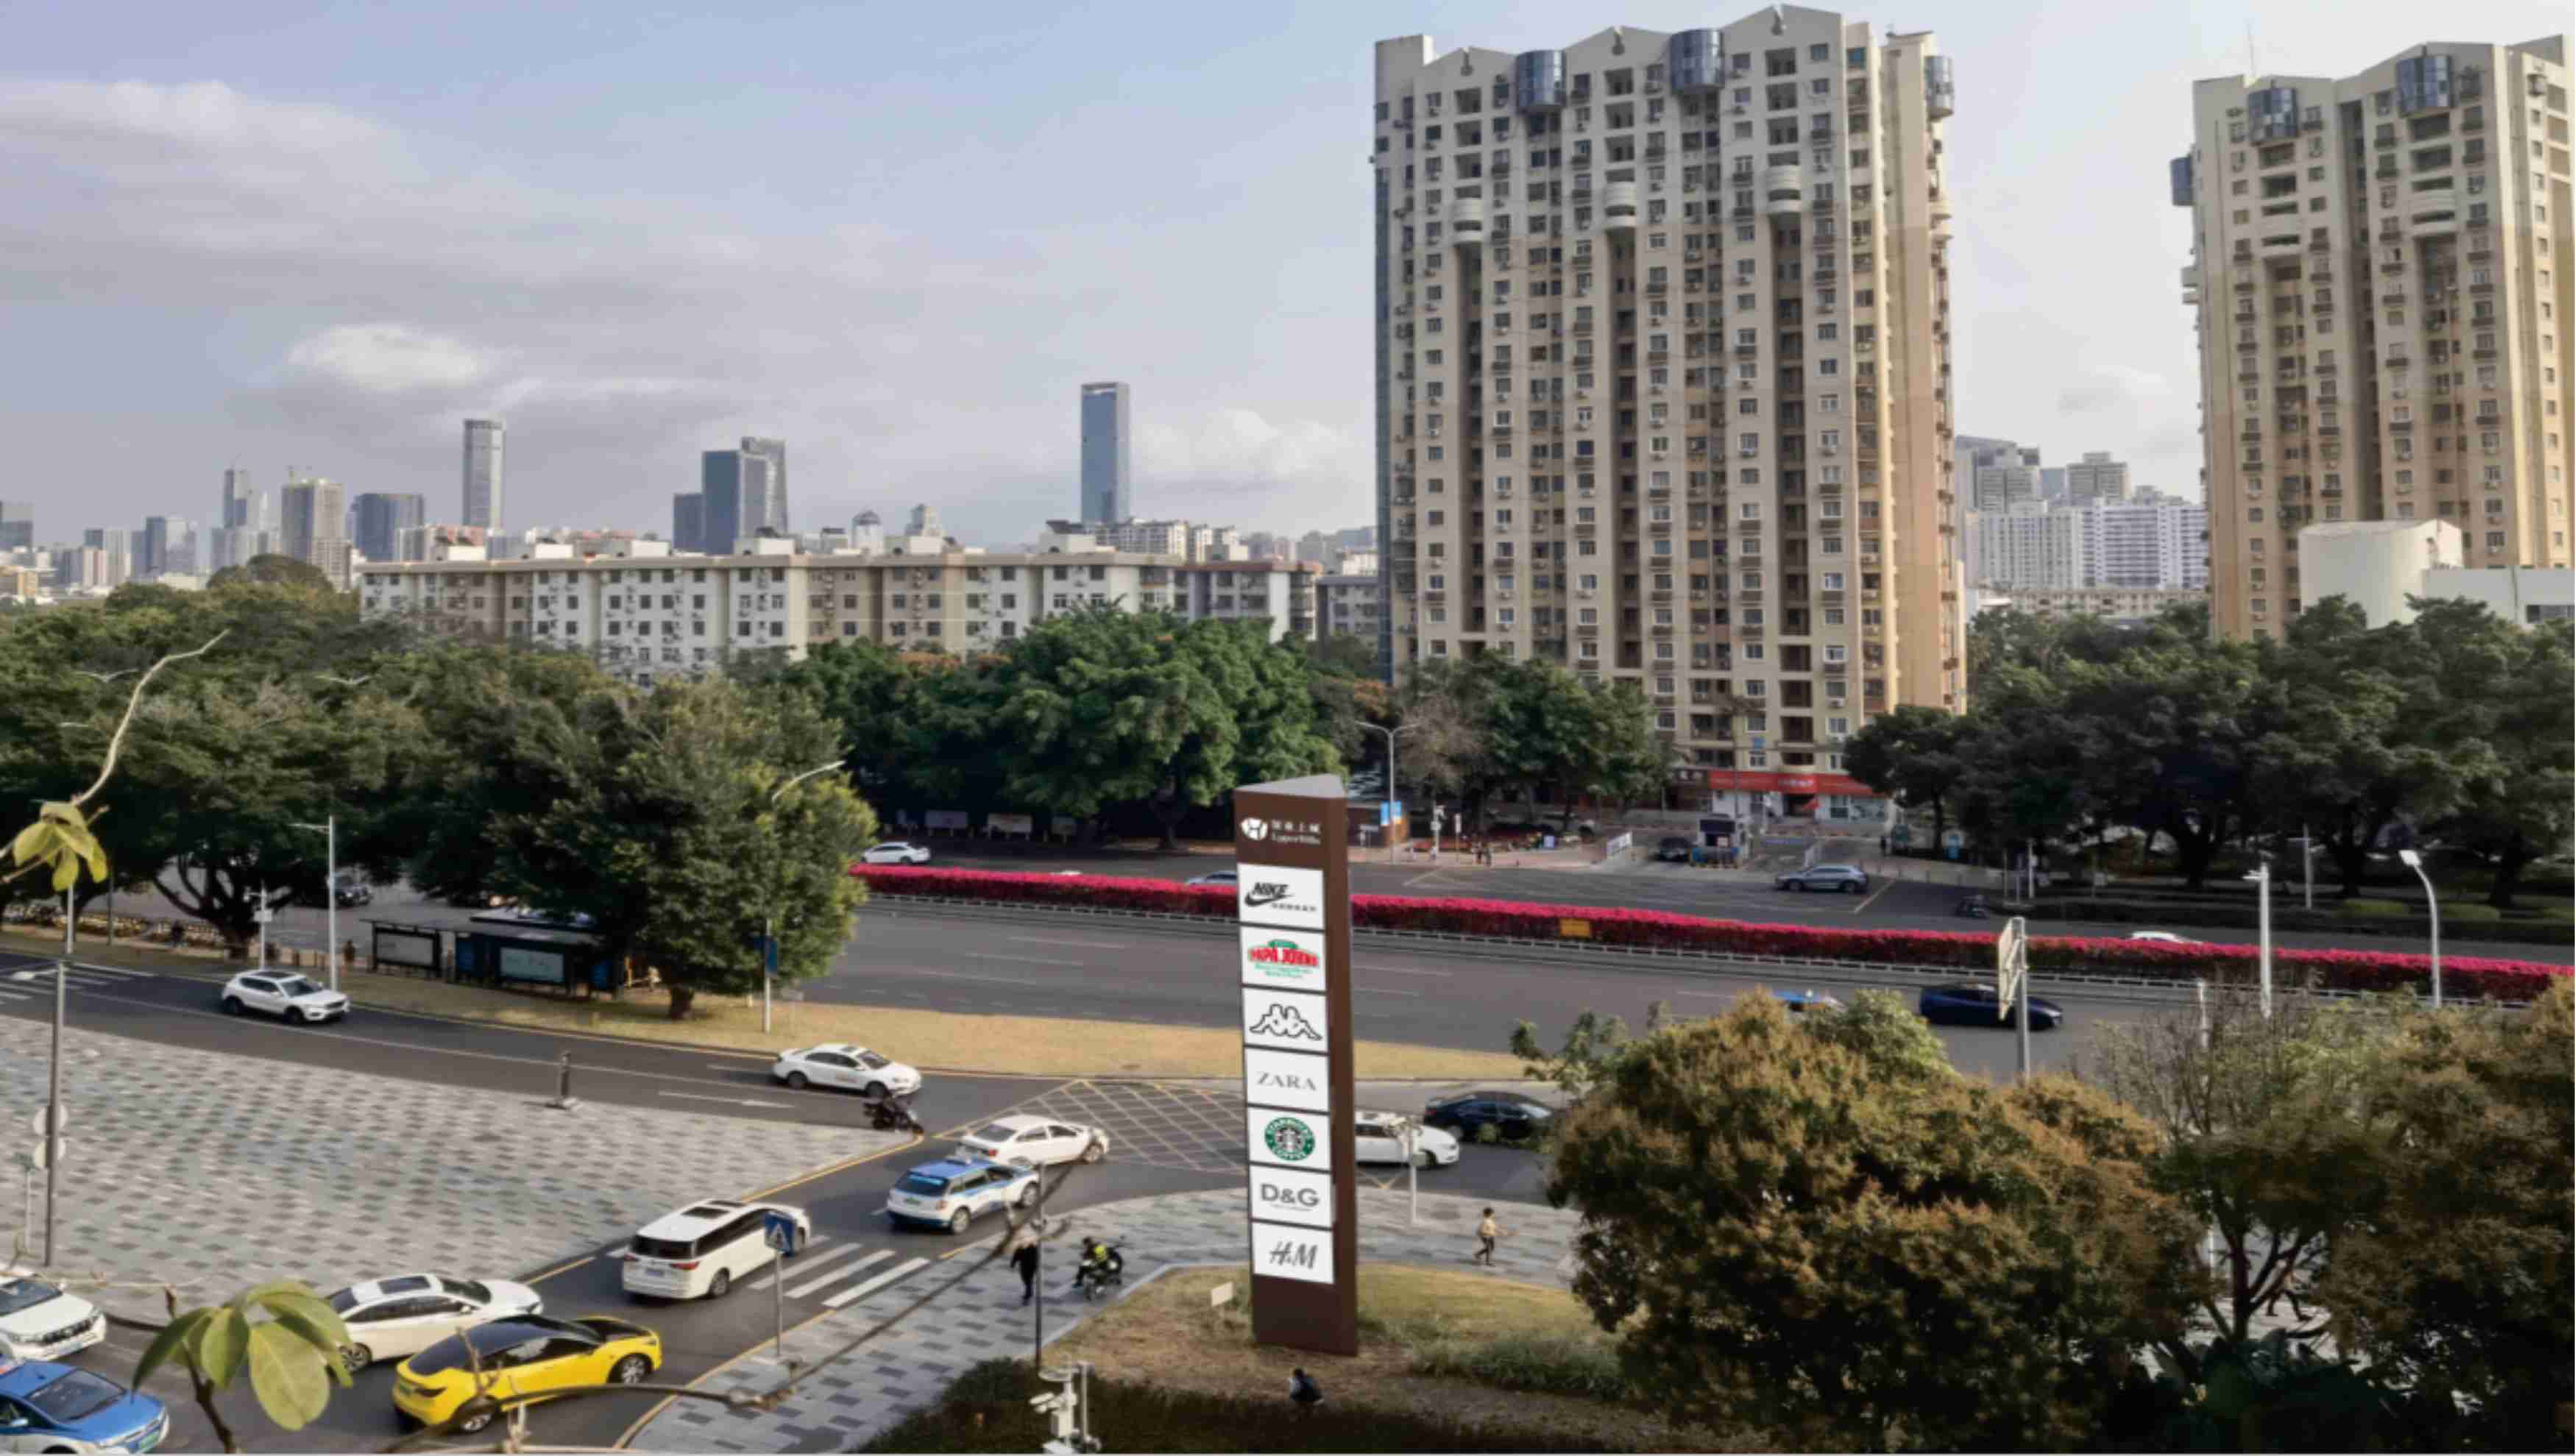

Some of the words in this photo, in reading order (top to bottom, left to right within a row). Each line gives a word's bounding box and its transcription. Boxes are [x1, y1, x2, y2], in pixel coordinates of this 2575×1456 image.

[1251, 882, 1289, 895] NIKE
[1257, 1071, 1317, 1091] ZARA
[1261, 1183, 1320, 1207] D&G
[1269, 1240, 1318, 1269] H&M
